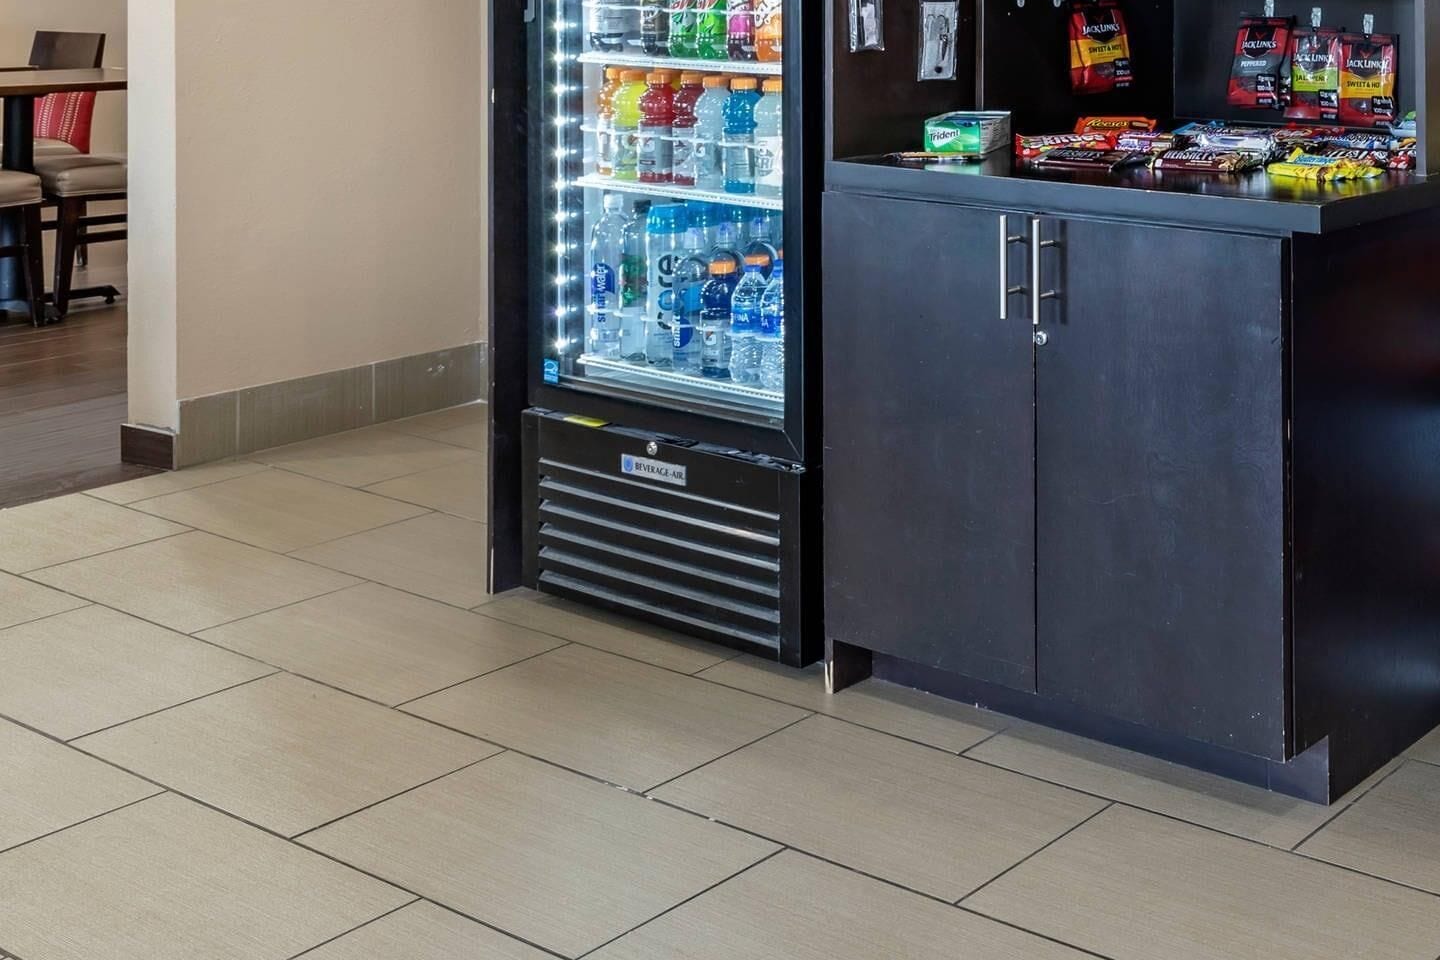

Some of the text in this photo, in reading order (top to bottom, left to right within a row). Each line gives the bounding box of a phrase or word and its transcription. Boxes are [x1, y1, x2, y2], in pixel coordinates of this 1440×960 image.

[1242, 40, 1256, 49] JACK
[1346, 60, 1363, 68] JACK
[930, 130, 959, 142] Trident
[634, 461, 685, 481] BEVERAGE-AIR
